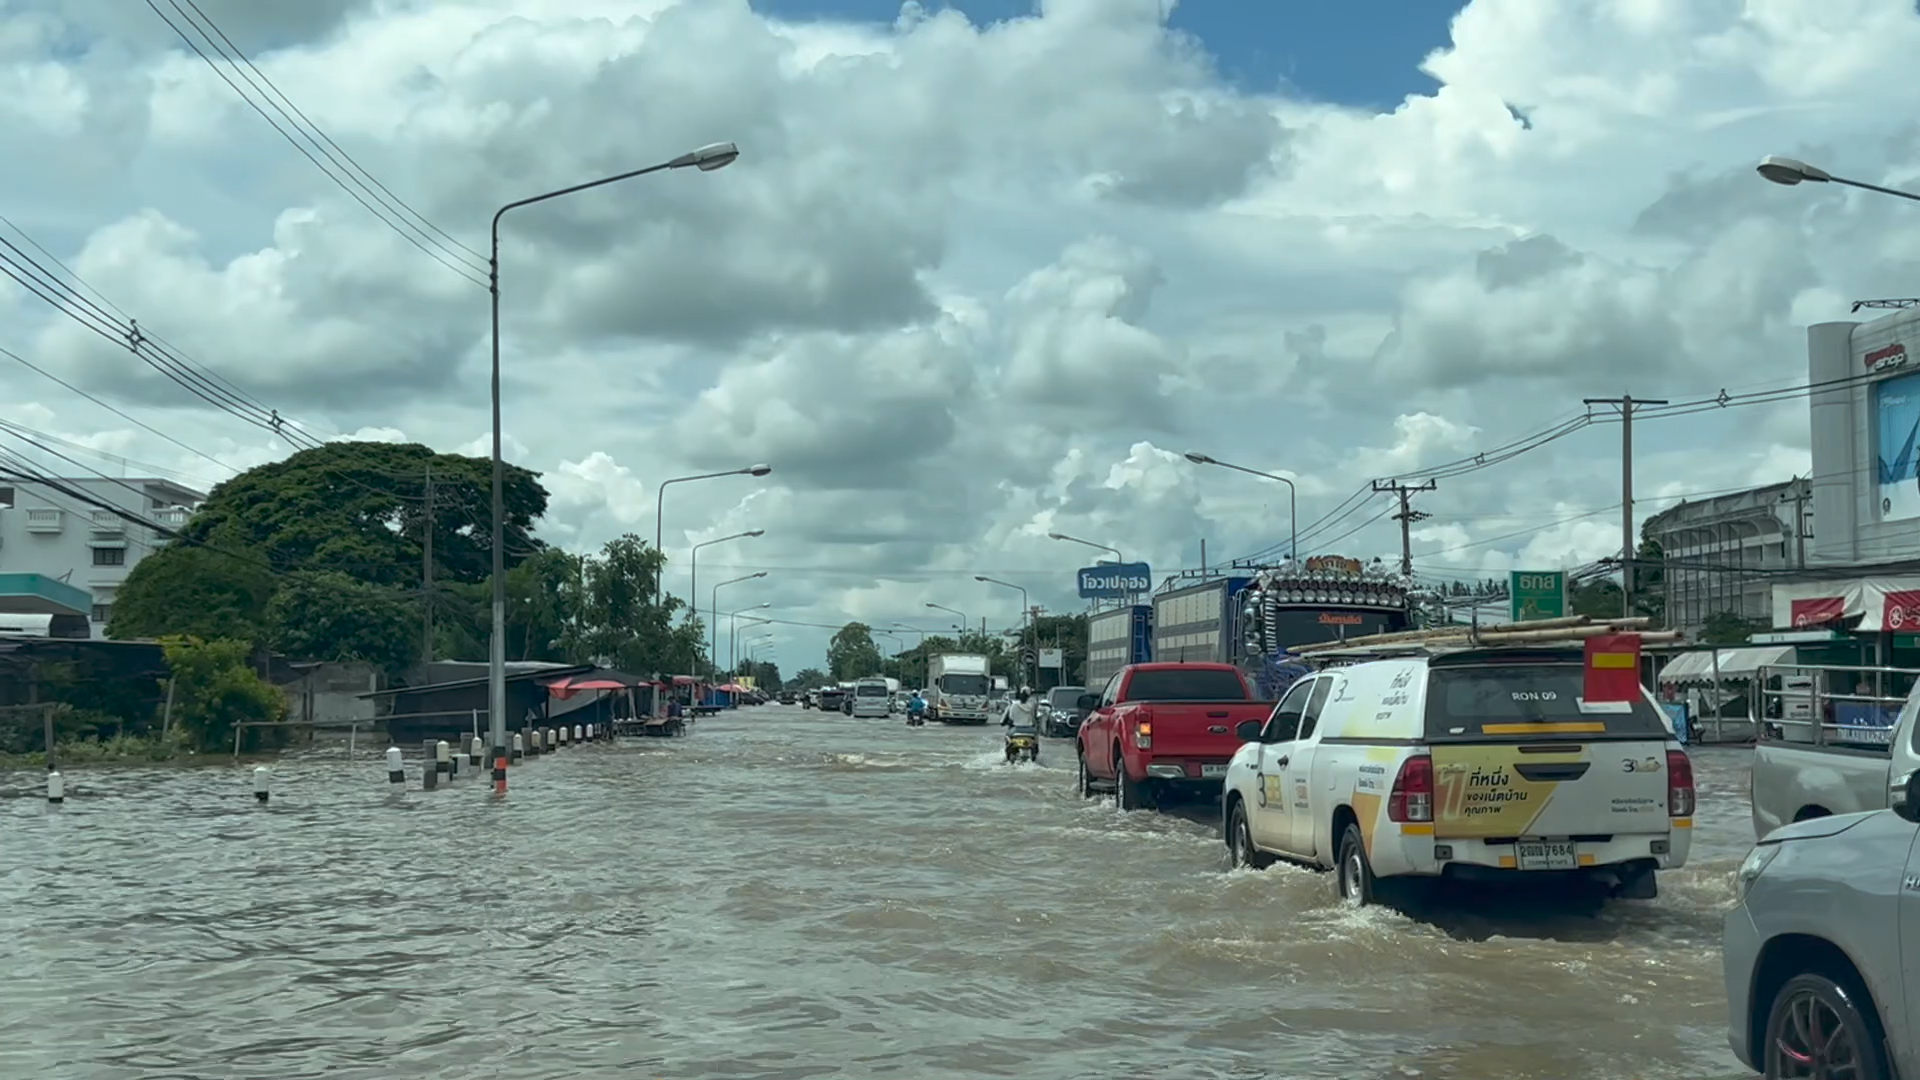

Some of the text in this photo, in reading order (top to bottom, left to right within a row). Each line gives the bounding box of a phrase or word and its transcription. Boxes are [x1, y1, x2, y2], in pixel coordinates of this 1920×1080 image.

[1875, 353, 1904, 369] shop
[1511, 691, 1557, 701] RON 09
[1469, 766, 1509, 787] ที่หนึ่ง
[1466, 788, 1528, 802] ของเน็ตบ้าน
[1464, 805, 1502, 817] คุณภาพ
